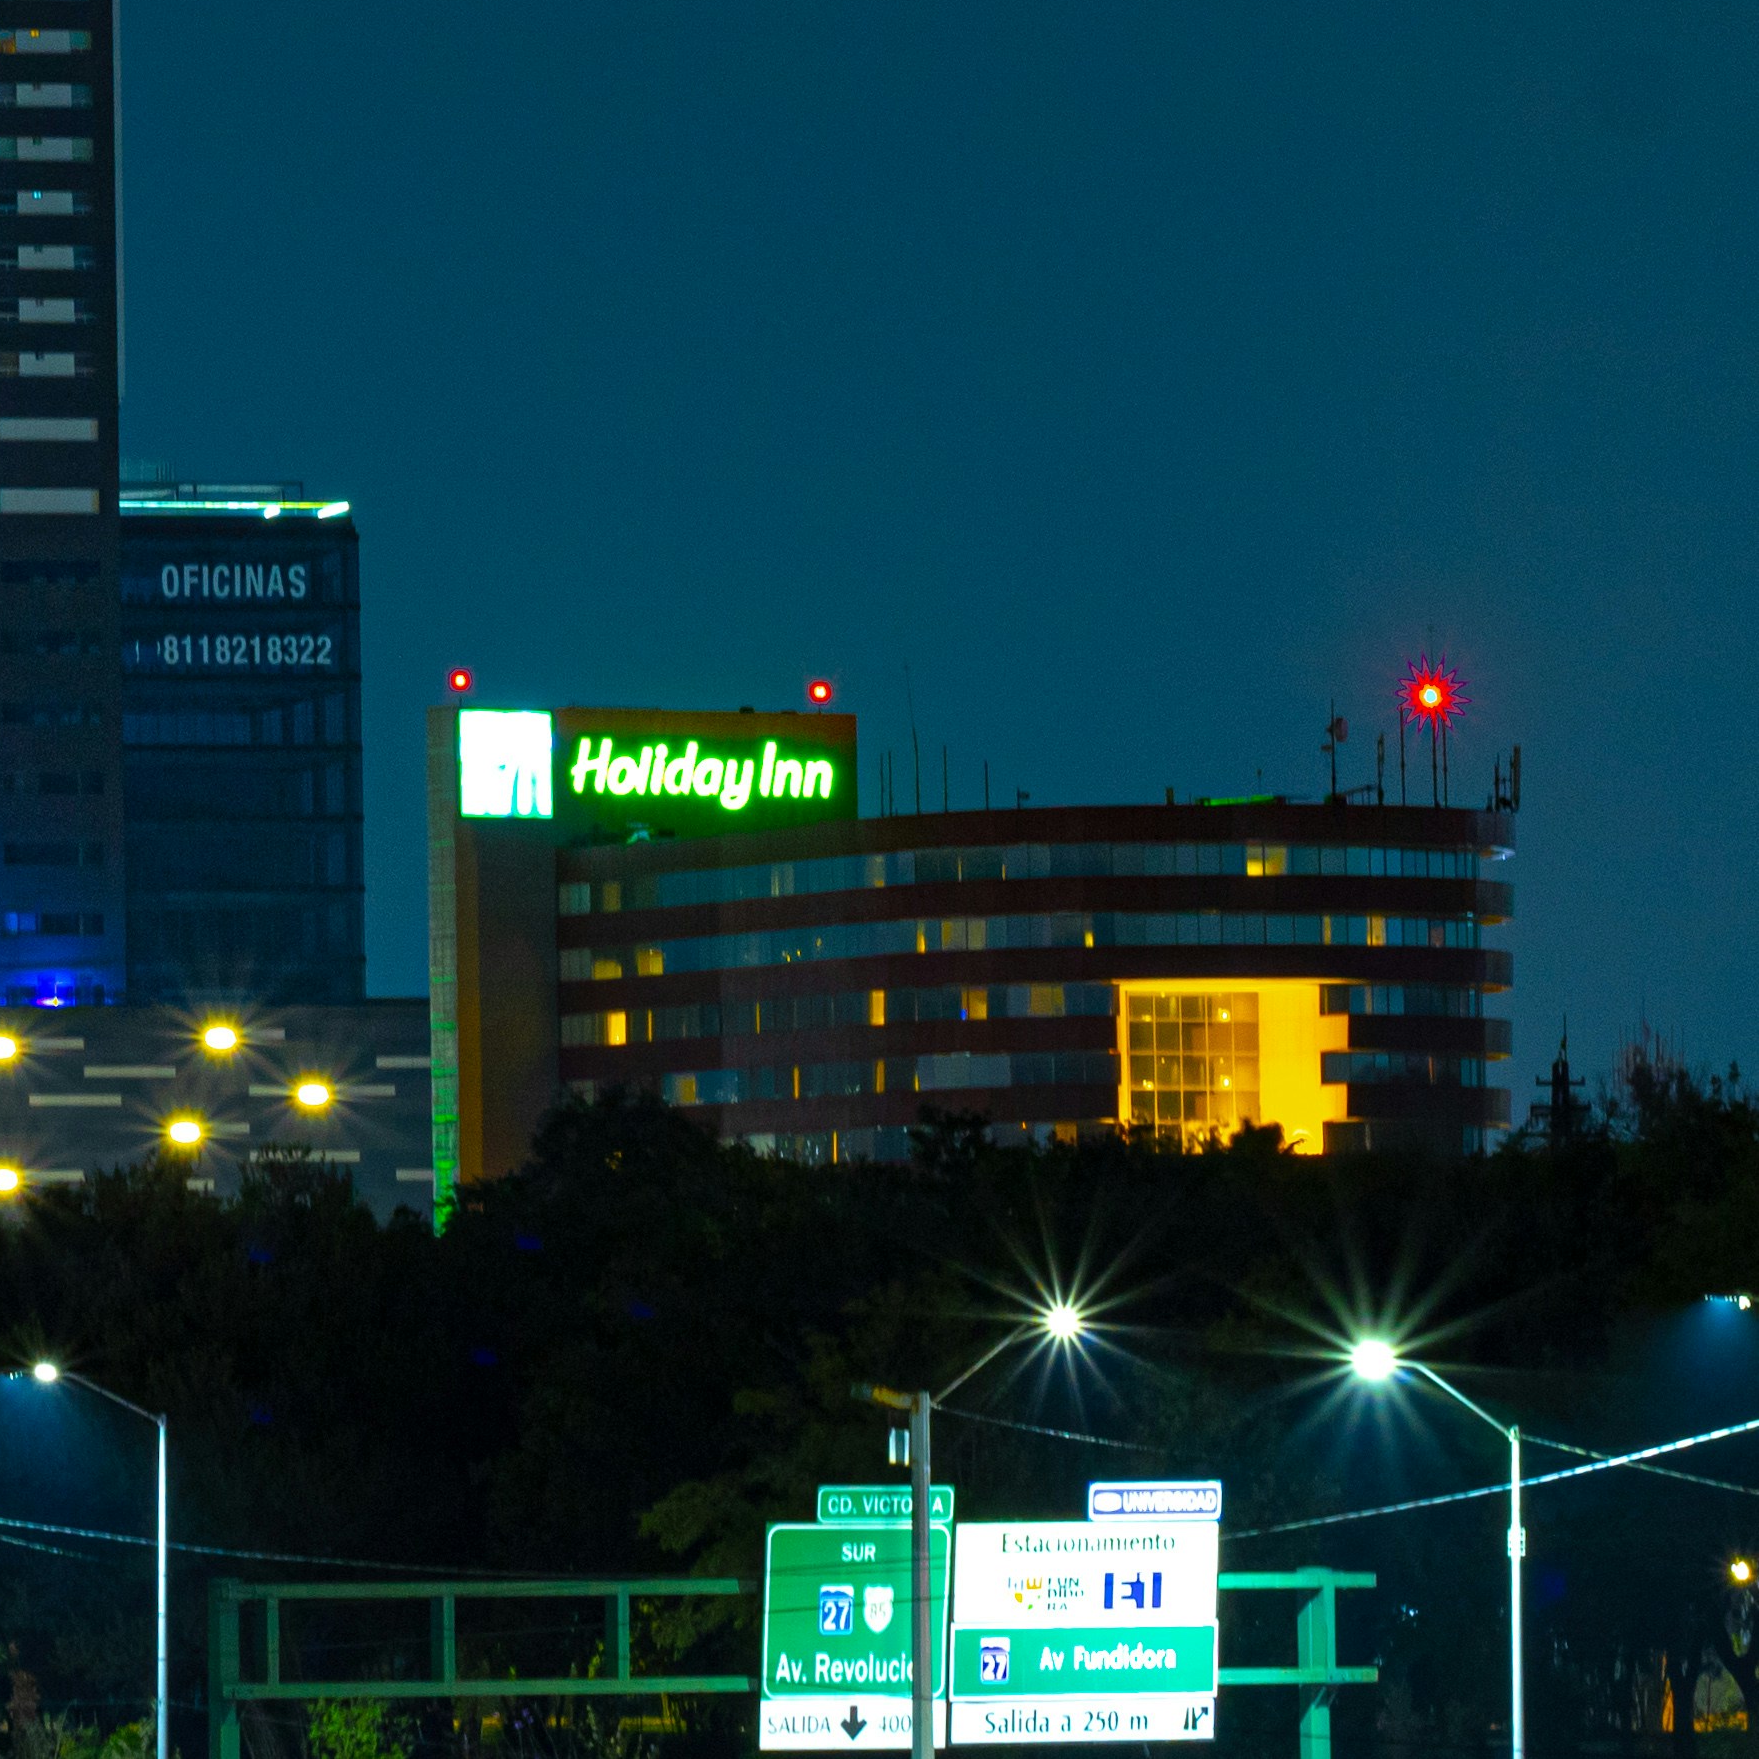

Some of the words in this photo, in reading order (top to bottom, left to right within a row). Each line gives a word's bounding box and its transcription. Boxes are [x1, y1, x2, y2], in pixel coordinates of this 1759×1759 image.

[161, 563, 306, 599] OFICINAS
[163, 634, 332, 665] 8118218322
[570, 737, 755, 811] Holiday
[758, 740, 834, 800] Inn
[827, 1494, 858, 1515] CD.
[862, 1494, 944, 1515] VICTOA
[841, 1542, 876, 1563] SUR
[1002, 1532, 1175, 1554] Estacionamiento
[823, 1600, 850, 1631] 27
[775, 1652, 808, 1684] Av.
[814, 1651, 914, 1684] Revoluci
[982, 1653, 1008, 1681] 27
[1039, 1646, 1065, 1671] Av
[1073, 1641, 1177, 1671] Fundidora
[767, 1714, 832, 1734] SALIDA
[984, 1708, 1050, 1735] Salida
[1060, 1715, 1072, 1732] a
[1083, 1710, 1120, 1732] 250
[1130, 1714, 1149, 1731] m
